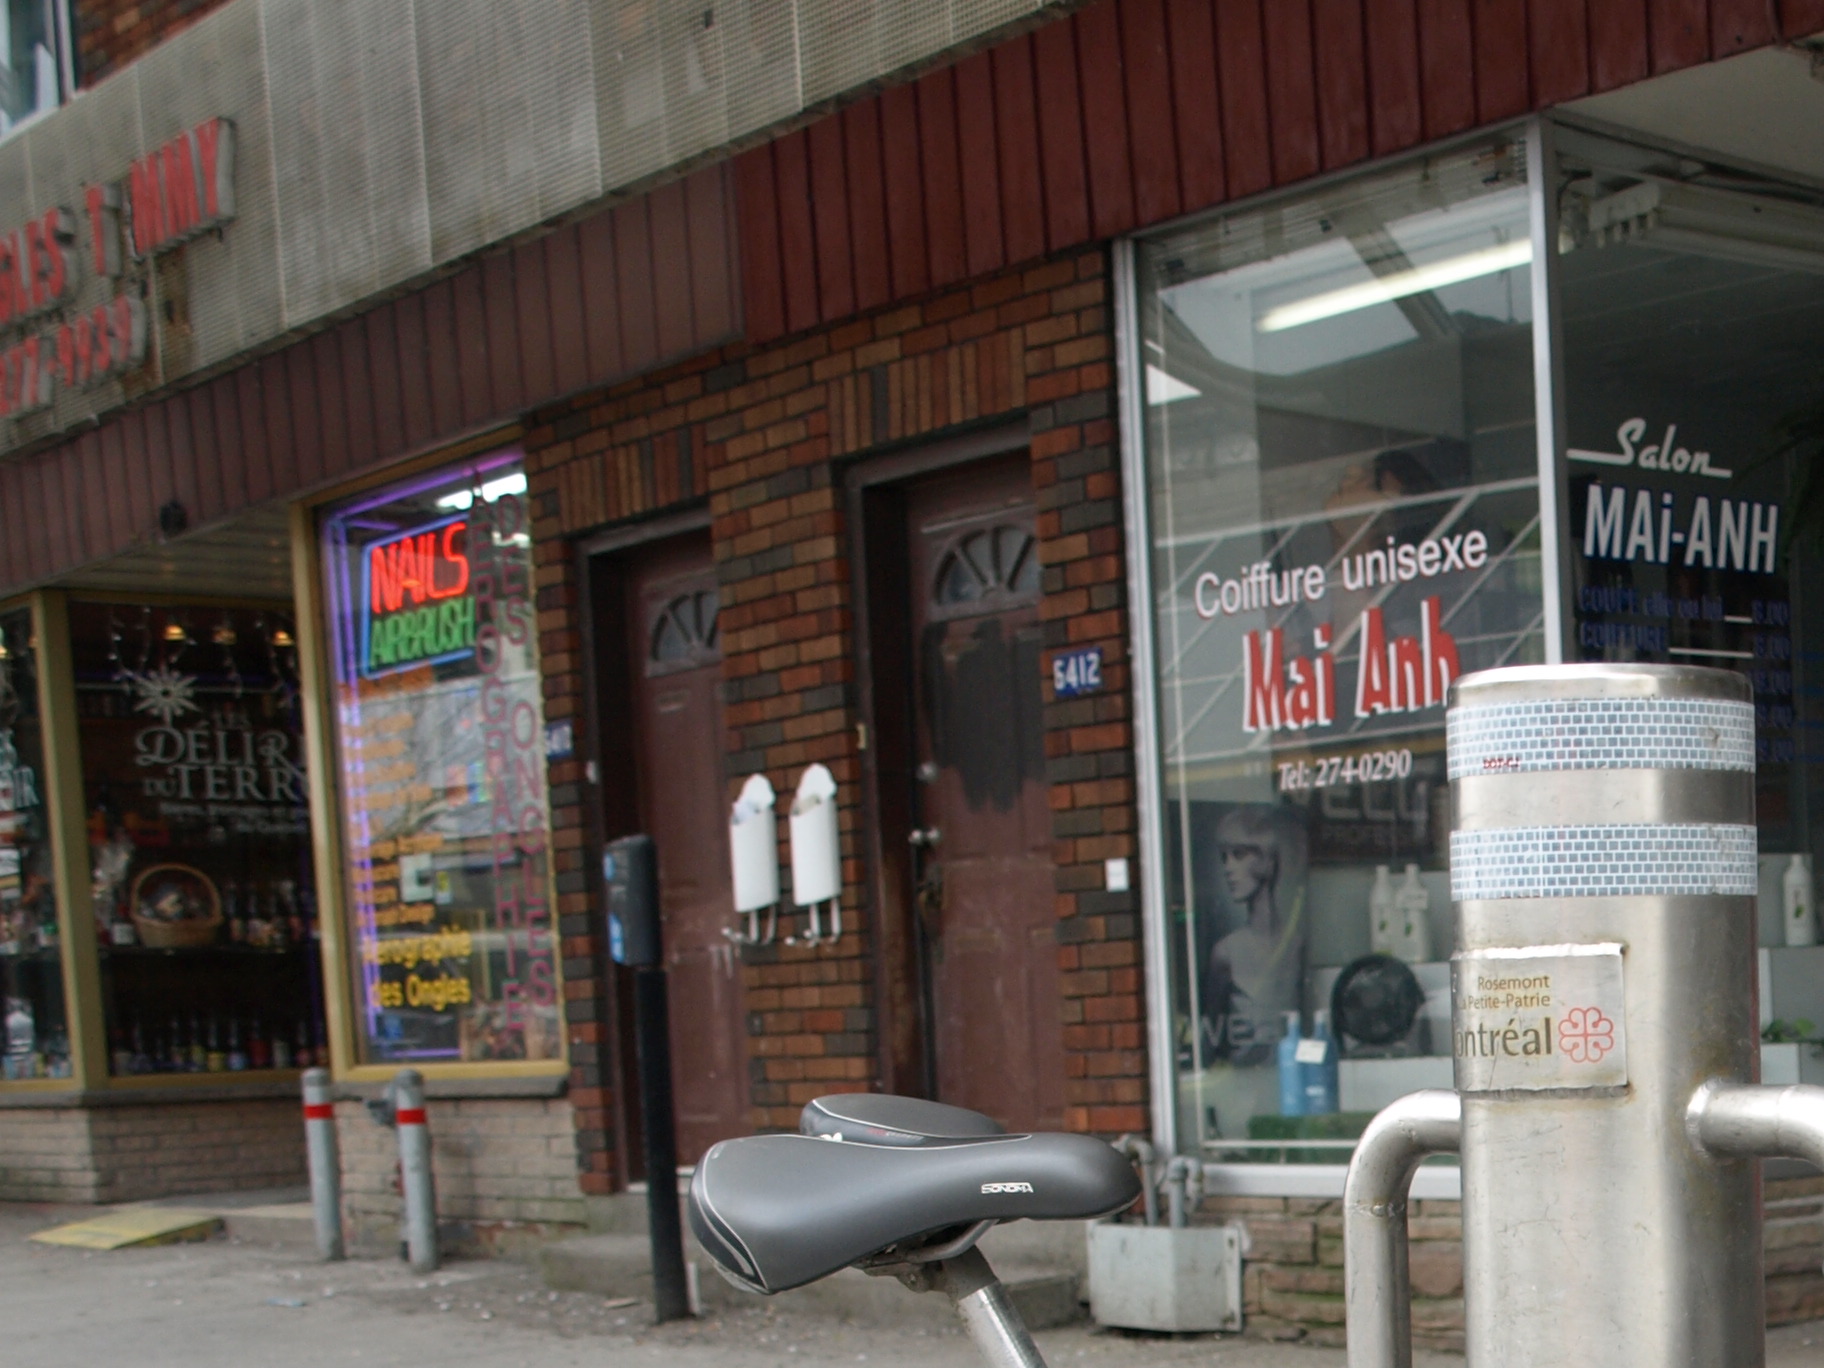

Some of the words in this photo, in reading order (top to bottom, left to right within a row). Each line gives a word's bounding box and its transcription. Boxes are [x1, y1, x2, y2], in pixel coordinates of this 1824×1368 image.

[1566, 417, 1733, 479] Salon
[371, 521, 470, 614] NAILS
[1195, 561, 1326, 618] Coiffure
[1342, 529, 1487, 591] unisexe
[370, 596, 476, 668] AIRBRUSH
[1053, 652, 1101, 690] 6412
[1242, 622, 1336, 733] Mai
[1354, 595, 1461, 718] Anh
[1315, 750, 1412, 788] 274-0290
[406, 973, 471, 1011] Ongles
[1469, 993, 1551, 1009] Petite-Patrie
[1478, 976, 1550, 991] Rosemont
[981, 1182, 1034, 1194] SONOMA
